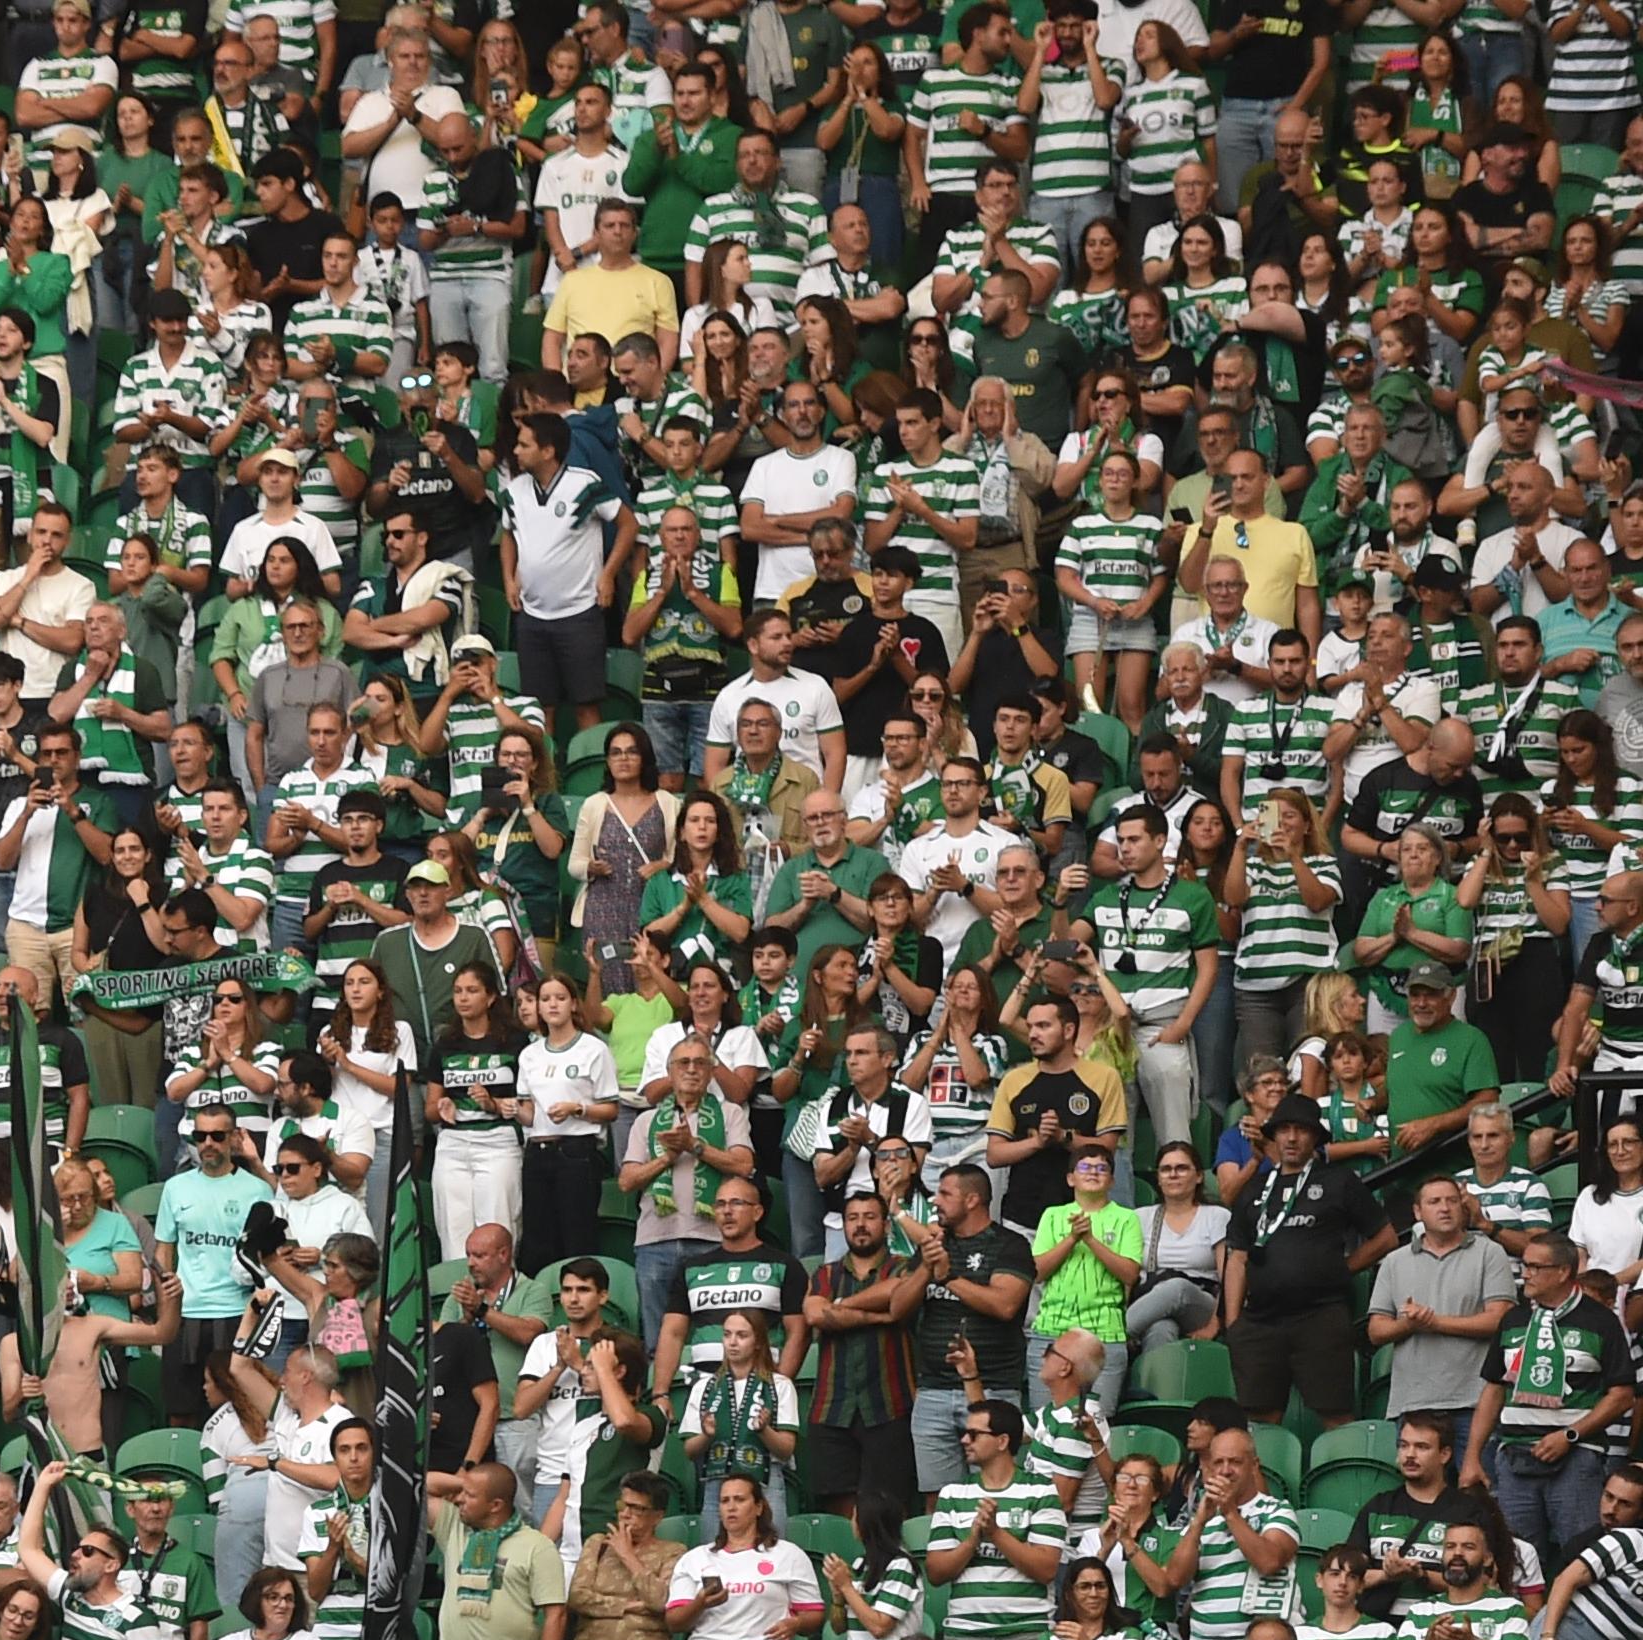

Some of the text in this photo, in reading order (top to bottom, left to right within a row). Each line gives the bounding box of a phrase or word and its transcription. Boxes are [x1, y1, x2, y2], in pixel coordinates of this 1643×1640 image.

[1093, 560, 1141, 575] Betano
[451, 748, 497, 769] Betan
[94, 955, 280, 998] SPORTING SEMPRE
[442, 1070, 496, 1086] Betano
[1283, 1212, 1315, 1227] ano
[185, 1231, 238, 1249] Betano
[696, 1286, 763, 1307] Betano
[549, 1382, 581, 1401] Bet
[724, 1577, 764, 1595] tano
[152, 1601, 180, 1620] ANO
